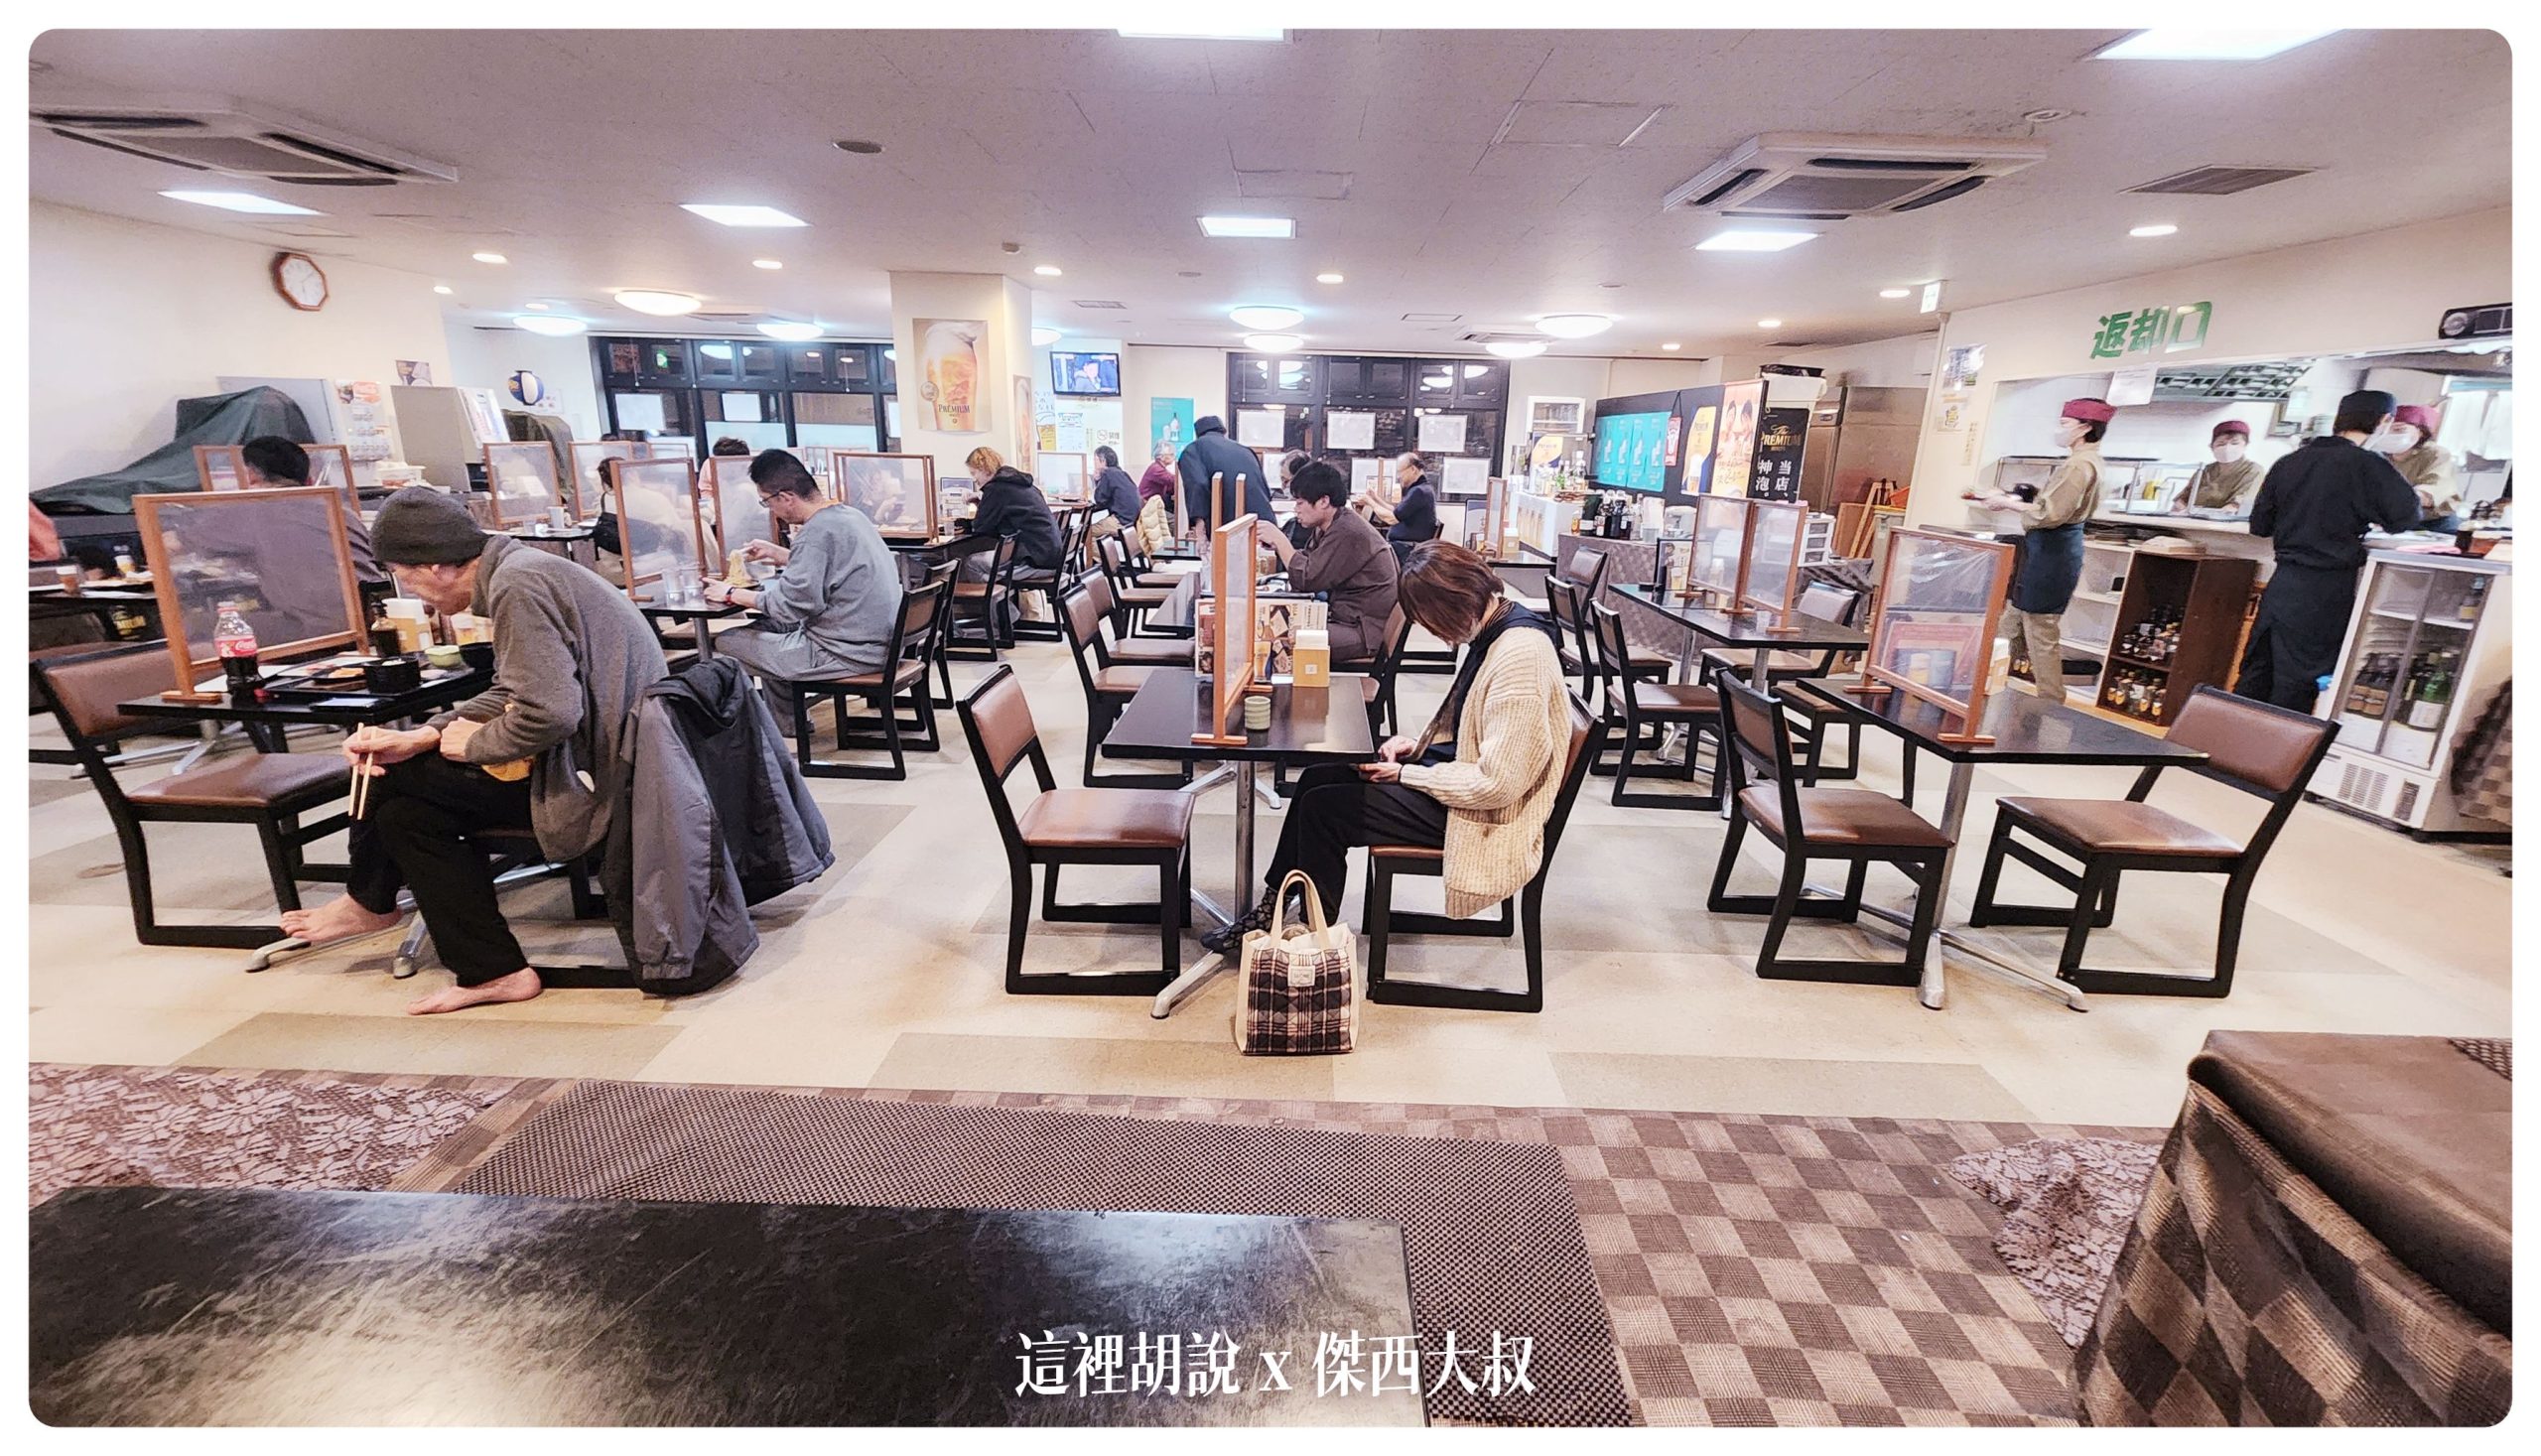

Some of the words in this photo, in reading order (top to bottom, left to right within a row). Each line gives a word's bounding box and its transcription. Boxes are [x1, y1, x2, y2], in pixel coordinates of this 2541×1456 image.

[2090, 302, 2212, 358] 返却口
[938, 404, 970, 414] PREMIUM
